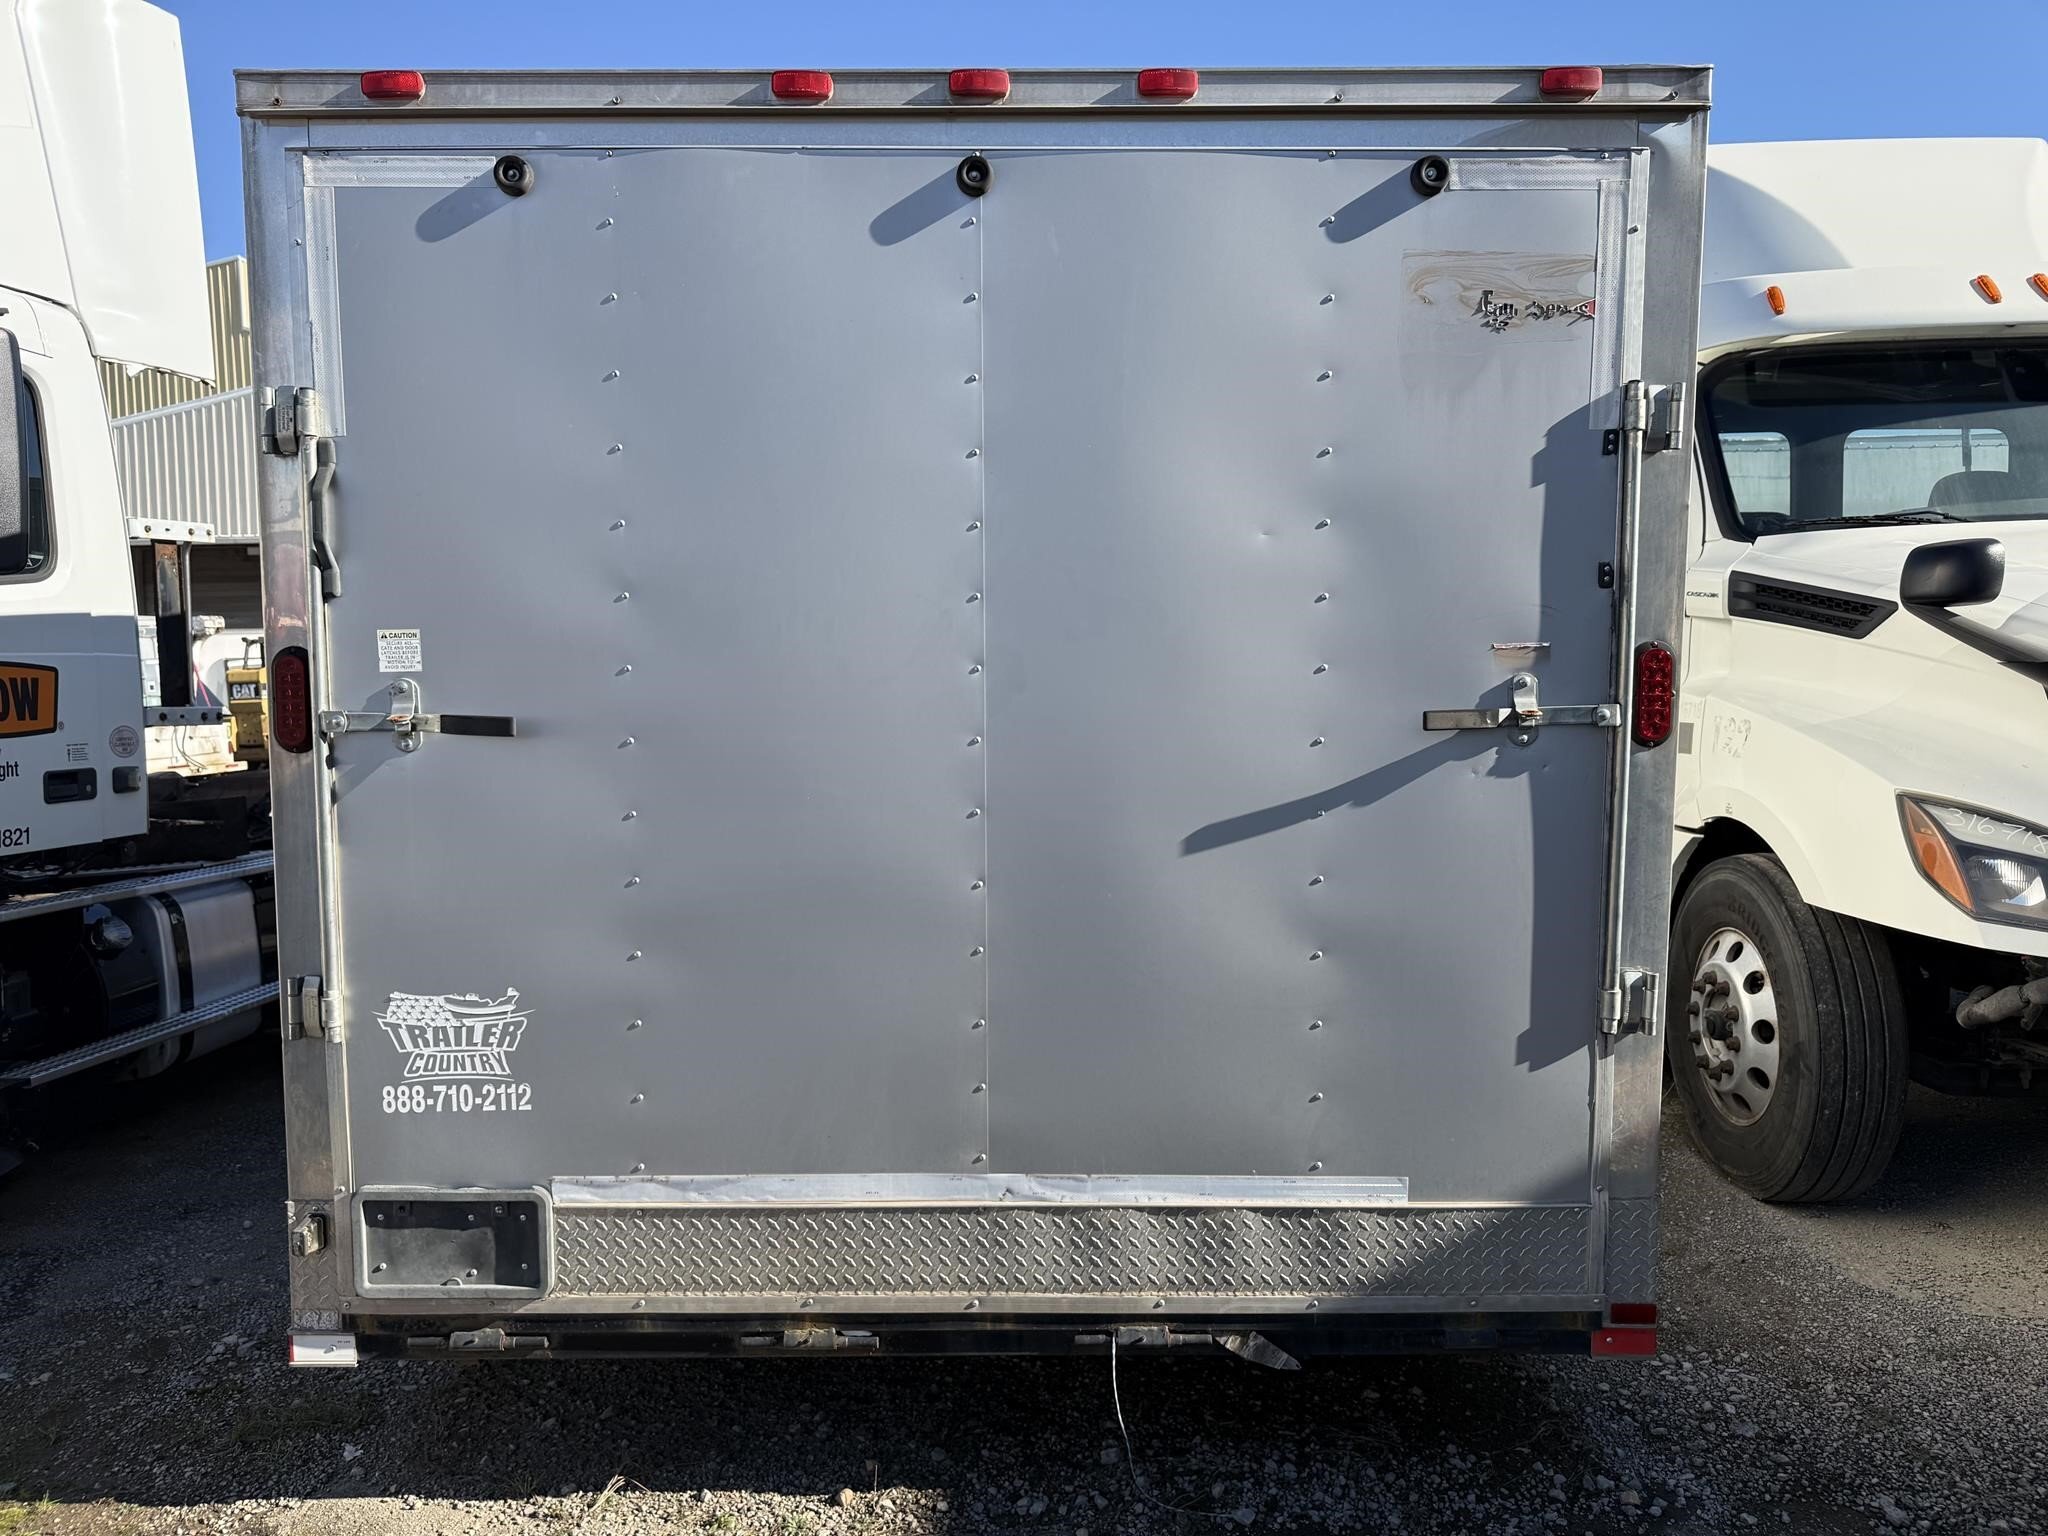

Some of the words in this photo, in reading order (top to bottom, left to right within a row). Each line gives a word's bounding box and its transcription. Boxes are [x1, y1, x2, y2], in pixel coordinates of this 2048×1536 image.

[232, 683, 256, 699] CAT
[378, 1018, 527, 1052] TRAILER
[404, 1051, 512, 1076] COUNTRY
[382, 1083, 532, 1113] 888-710-2112
